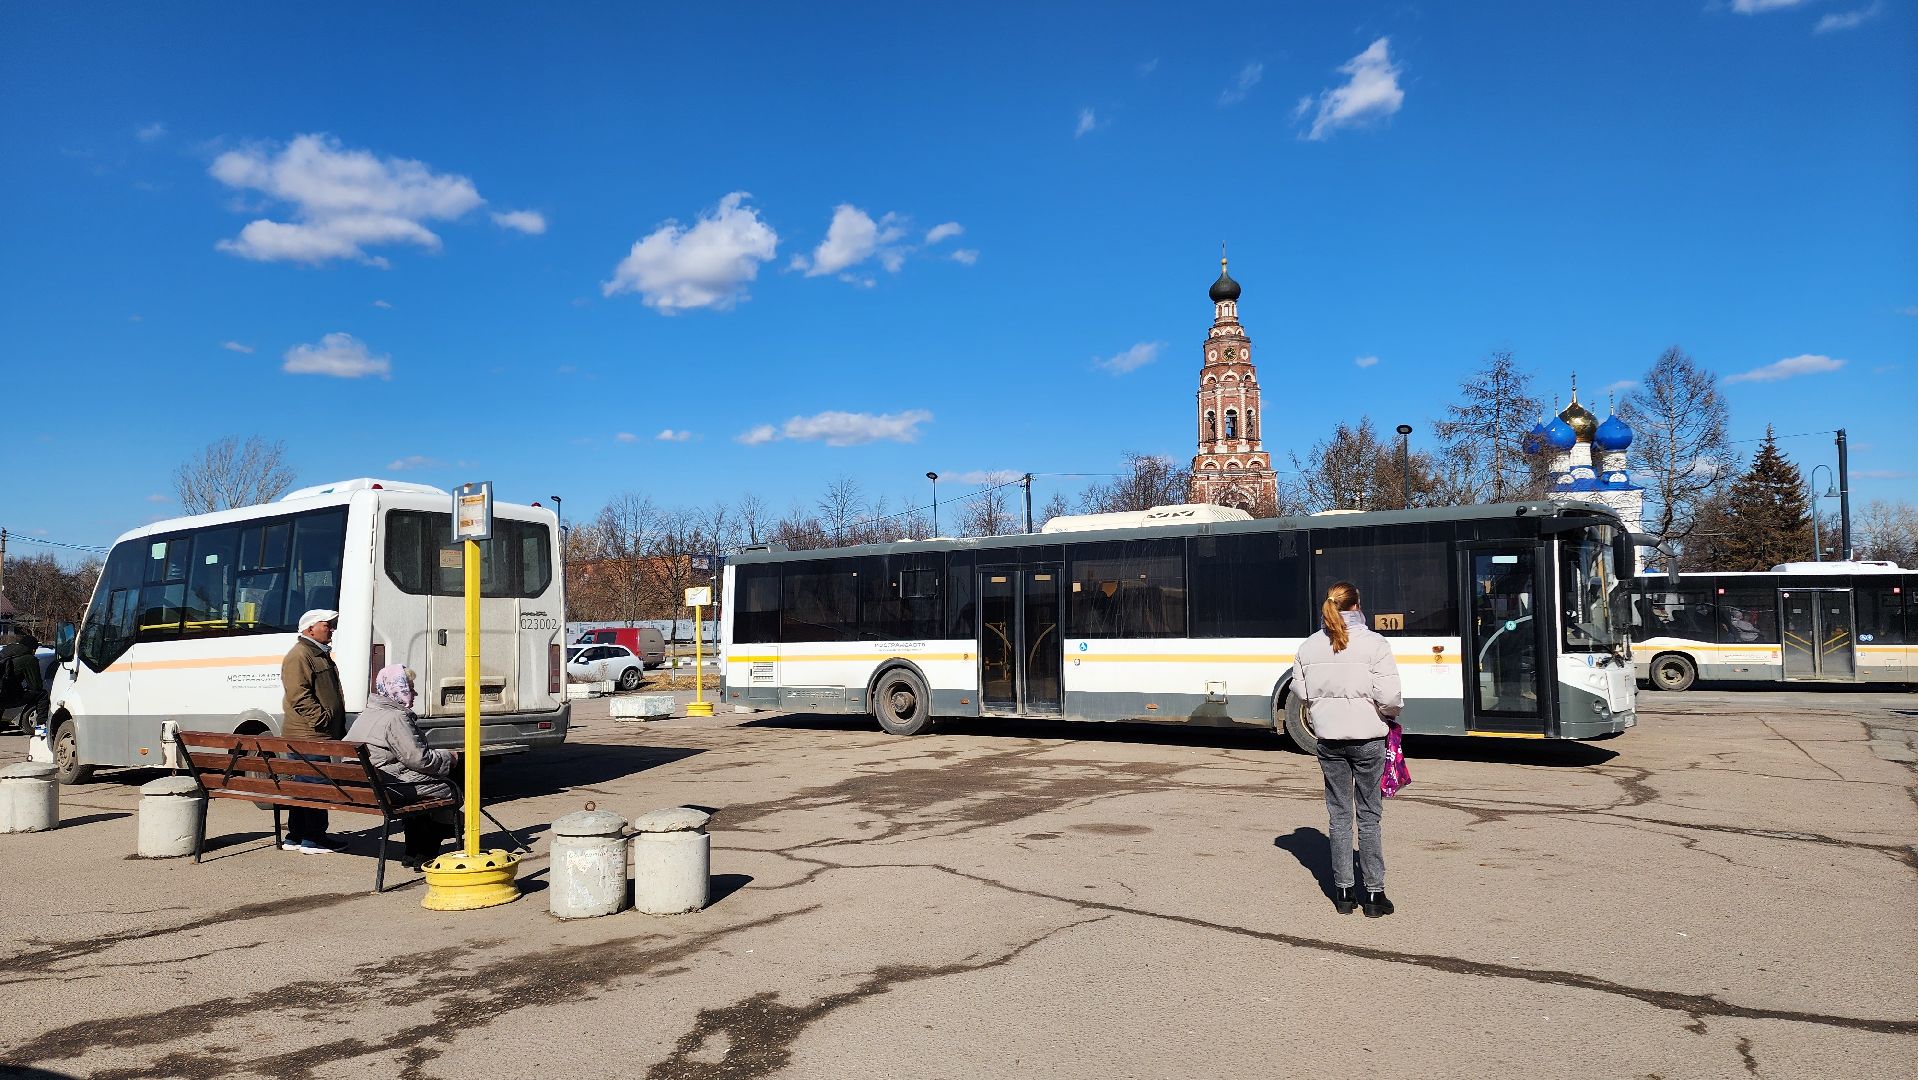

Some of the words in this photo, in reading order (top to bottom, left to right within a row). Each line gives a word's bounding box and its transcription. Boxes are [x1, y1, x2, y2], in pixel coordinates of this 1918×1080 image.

[521, 618, 557, 630] 023002
[1380, 617, 1399, 631] 30
[227, 673, 281, 682] МОСТРАНСАВТ
